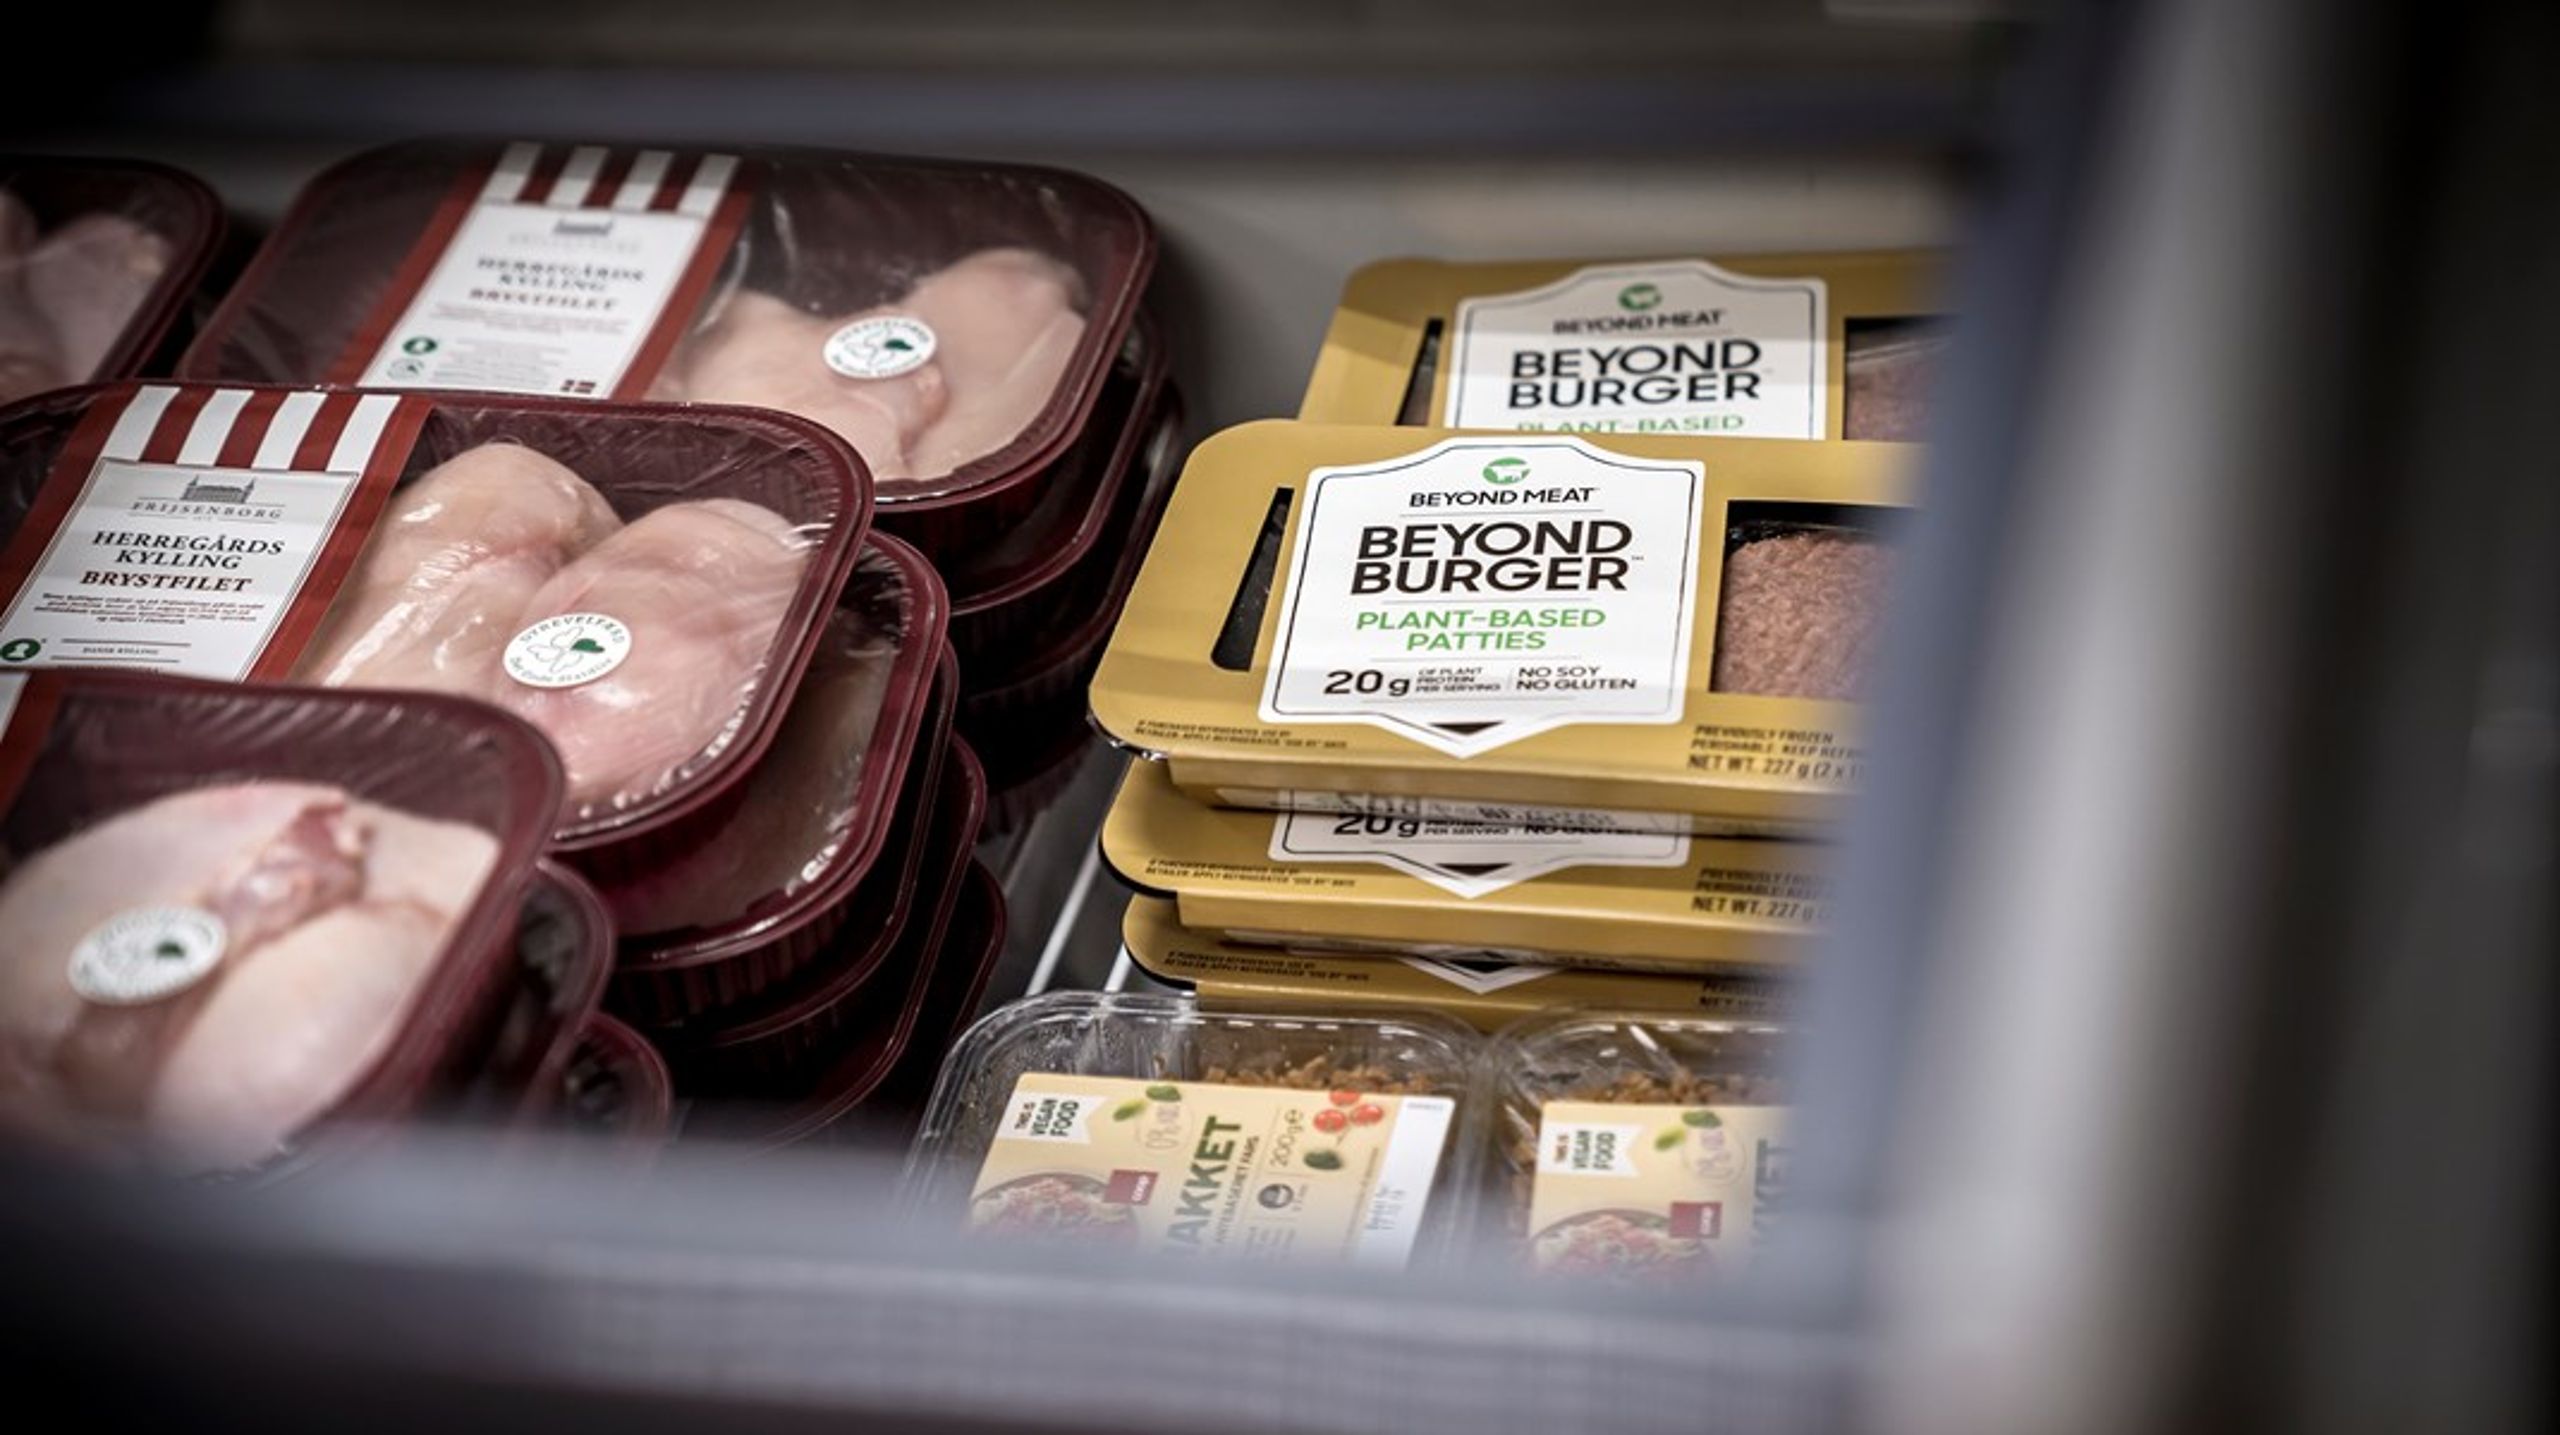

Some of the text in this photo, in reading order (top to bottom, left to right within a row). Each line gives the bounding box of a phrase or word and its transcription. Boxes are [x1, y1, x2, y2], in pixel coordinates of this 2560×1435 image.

[1553, 311, 1724, 335] BEYOND MEAT
[1511, 339, 1762, 379] BEYOND
[1508, 372, 1761, 410] BURGER
[1409, 488, 1593, 507] BEYOND MEAT
[131, 502, 283, 519] FRIJSENBORG
[92, 531, 286, 556] HERREGÅRDS
[1358, 520, 1633, 560] BEYOND
[115, 549, 243, 570] KYLLING
[80, 571, 253, 593] BRYSTFILET
[1350, 557, 1630, 595] BURGER
[1356, 609, 1606, 630] PLANT-BASED
[1405, 631, 1547, 651] PATTIES
[1416, 676, 1476, 684] PROTEIN
[1441, 667, 1483, 676] PLANT
[1518, 666, 1602, 677] NO SOY
[1415, 684, 1501, 693] PER SERVING
[1515, 679, 1637, 691] NO GLUTEN
[1778, 729, 1834, 743] FROZEN
[1688, 754, 1723, 770] NET
[1762, 758, 1795, 775] 227
[1691, 896, 1728, 913] NET
[1030, 1099, 1058, 1137] VEGAN
[1049, 1101, 1079, 1137] FOOD
[1594, 1131, 1616, 1171] FOOD
